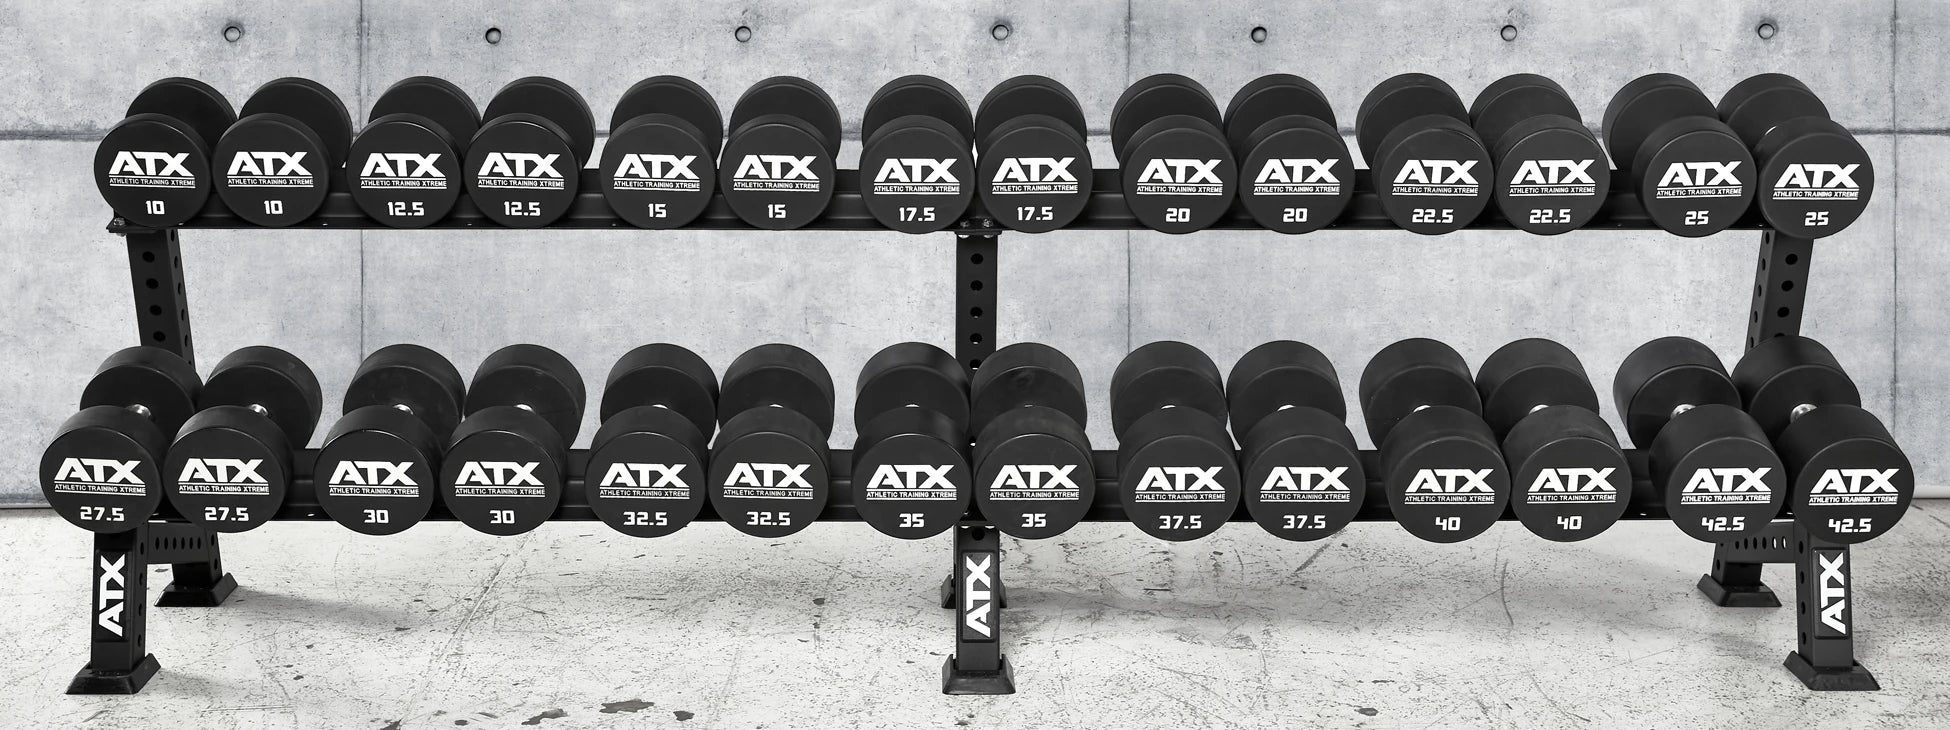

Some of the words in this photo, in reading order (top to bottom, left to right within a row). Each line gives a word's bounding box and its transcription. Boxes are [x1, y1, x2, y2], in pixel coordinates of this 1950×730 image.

[109, 151, 194, 176] ATX
[227, 152, 312, 175] ATX
[361, 153, 445, 177] ATX
[478, 152, 563, 177] ATX
[614, 154, 699, 179] ATX
[734, 155, 819, 179] ATX
[874, 159, 959, 182] ATX
[993, 157, 1077, 182] ATX
[1138, 159, 1223, 183] ATX
[1255, 159, 1340, 183] ATX
[1394, 160, 1478, 184] ATX
[1511, 160, 1595, 184] ATX
[1658, 161, 1742, 186] ATX
[1775, 164, 1860, 188] ATX
[109, 177, 139, 185] ATHLETIC
[141, 178, 169, 186] TRAINING
[478, 178, 508, 186] ATHLETIC
[509, 179, 538, 187] TRAINING
[539, 180, 564, 188] XTREME
[613, 180, 643, 188] ATHLETIC
[645, 180, 674, 189] TRAINING
[675, 181, 699, 189] XTREME
[992, 184, 1022, 192] ATHLETIC
[1023, 184, 1052, 192] TRAINING
[1053, 184, 1077, 192] XTREME
[1424, 186, 1452, 194] TRAINING
[1541, 186, 1568, 194] TRAINING
[1656, 189, 1686, 197] ATHLETIC
[1688, 188, 1716, 196] TRAINING
[1773, 190, 1802, 198] ATHLETIC
[1804, 190, 1832, 198] TRAINING
[1834, 190, 1859, 198] XTREME
[146, 201, 164, 214] 10
[264, 201, 283, 214] 10
[388, 202, 424, 215] 12.5
[504, 202, 540, 216] 12.5
[648, 204, 666, 217] 15
[768, 204, 786, 218] 15
[900, 207, 935, 221] 17.5
[1018, 207, 1053, 220] 17.5
[1166, 208, 1190, 222] 20
[1283, 208, 1307, 222] 20
[1412, 209, 1453, 223] 22.5
[1530, 209, 1570, 223] 22.5
[1685, 211, 1709, 225] 25
[1805, 212, 1829, 226] 25
[55, 458, 145, 484] ATX
[178, 458, 267, 483] ATX
[329, 461, 418, 485] ATX
[455, 462, 544, 485] ATX
[600, 463, 689, 487] ATX
[724, 463, 812, 488] ATX
[867, 465, 956, 488] ATX
[991, 465, 1079, 488] ATX
[1136, 467, 1225, 490] ATX
[1261, 467, 1350, 490] ATX
[1406, 469, 1494, 492] ATX
[1528, 468, 1616, 492] ATX
[1683, 468, 1771, 492] ATX
[1811, 469, 1899, 493] ATX
[54, 483, 86, 492] ATHLETIC
[88, 484, 118, 493] TRAINING
[120, 486, 145, 494] XTREME
[179, 484, 210, 492] ATHLETIC
[243, 485, 269, 493] XTREME
[787, 490, 813, 498] XTREME
[1714, 494, 1743, 502] TRAINING
[81, 506, 124, 521] 27.5
[205, 507, 249, 521] 27.5
[364, 510, 388, 523] 30
[490, 510, 514, 523] 30
[624, 512, 667, 525] 32.5
[747, 512, 790, 525] 32.5
[900, 514, 924, 527] 35
[1022, 514, 1046, 527] 35
[1159, 515, 1201, 529] 37.5
[1283, 515, 1325, 528] 37.5
[1436, 517, 1460, 530] 40
[1557, 516, 1582, 529] 40
[1702, 517, 1745, 531] 42.5
[1829, 518, 1871, 532] 42.5
[99, 554, 125, 637] ATX
[966, 554, 991, 637] ATX
[1819, 552, 1846, 635] ATX
